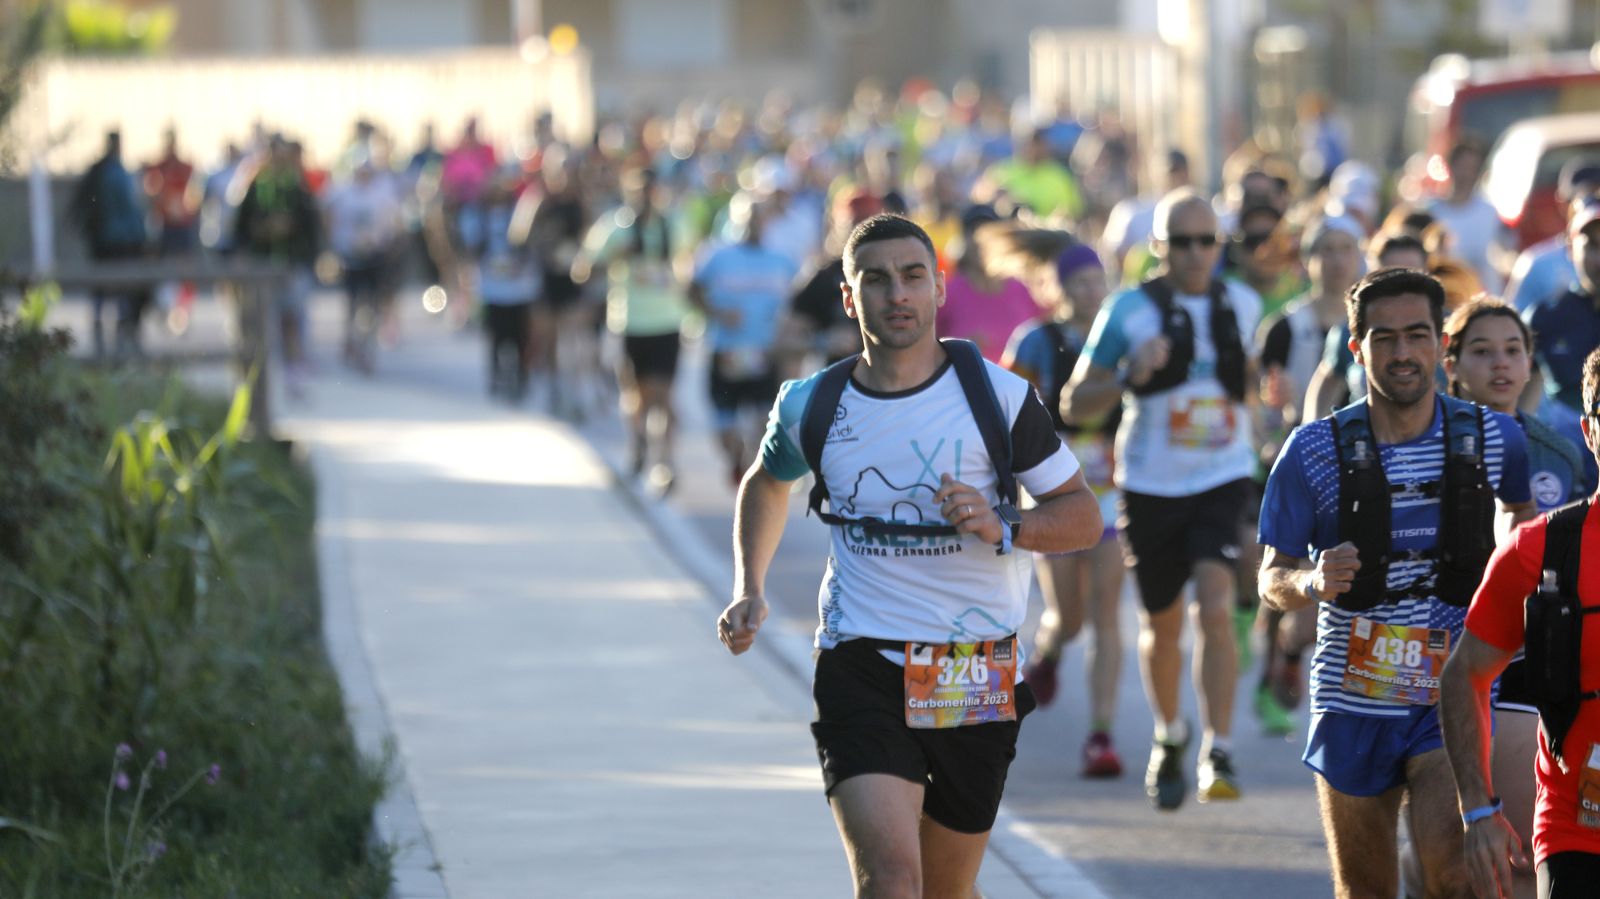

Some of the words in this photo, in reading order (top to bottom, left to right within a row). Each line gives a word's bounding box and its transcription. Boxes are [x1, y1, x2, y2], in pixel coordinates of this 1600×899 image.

[850, 545, 887, 557] SIERRA
[894, 543, 962, 557] CARBONERA
[1372, 636, 1422, 668] 438
[937, 654, 989, 686] 326
[1347, 664, 1411, 687] Carbonerilla
[1413, 678, 1440, 689] 2023
[908, 696, 981, 709] Carbonerilla
[983, 694, 1009, 706] 2023
